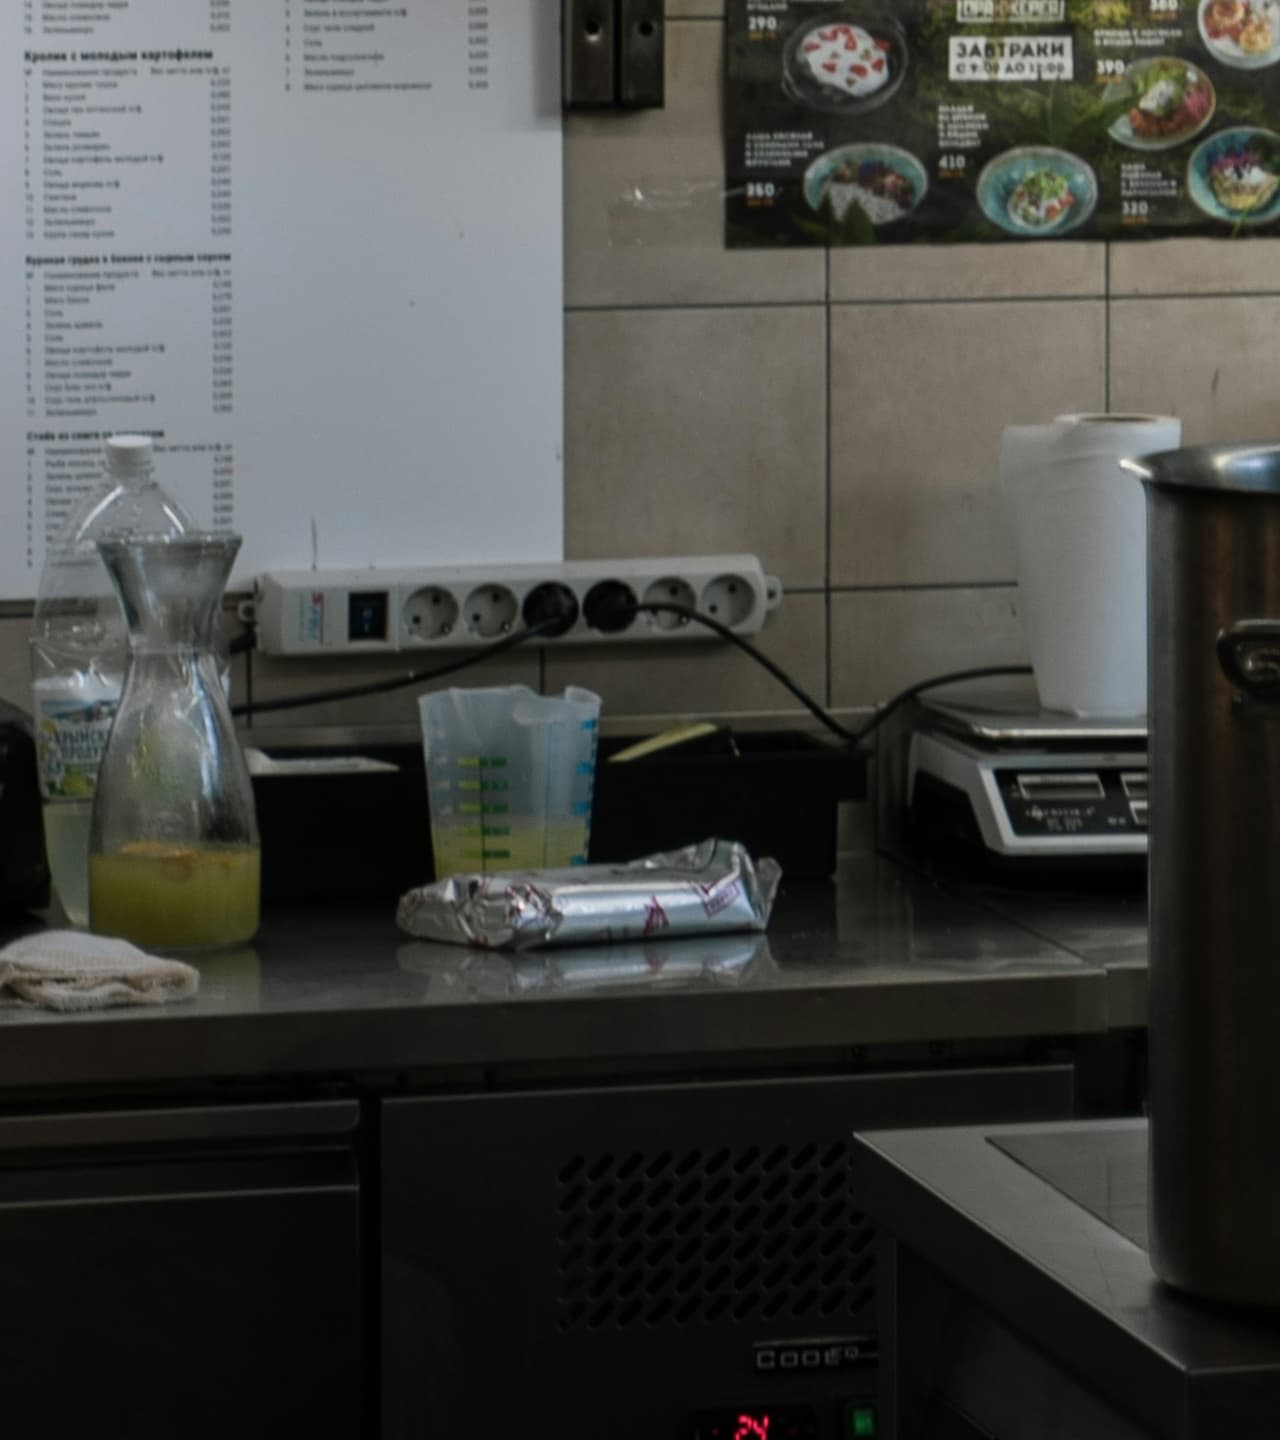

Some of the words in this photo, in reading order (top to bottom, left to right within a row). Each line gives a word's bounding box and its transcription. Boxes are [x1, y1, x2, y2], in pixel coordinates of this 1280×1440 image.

[25, 49, 67, 63] Кролик
[81, 50, 138, 63] молодым
[141, 48, 213, 63] картофелем
[956, 41, 1065, 58] ЗАВТРАКИ
